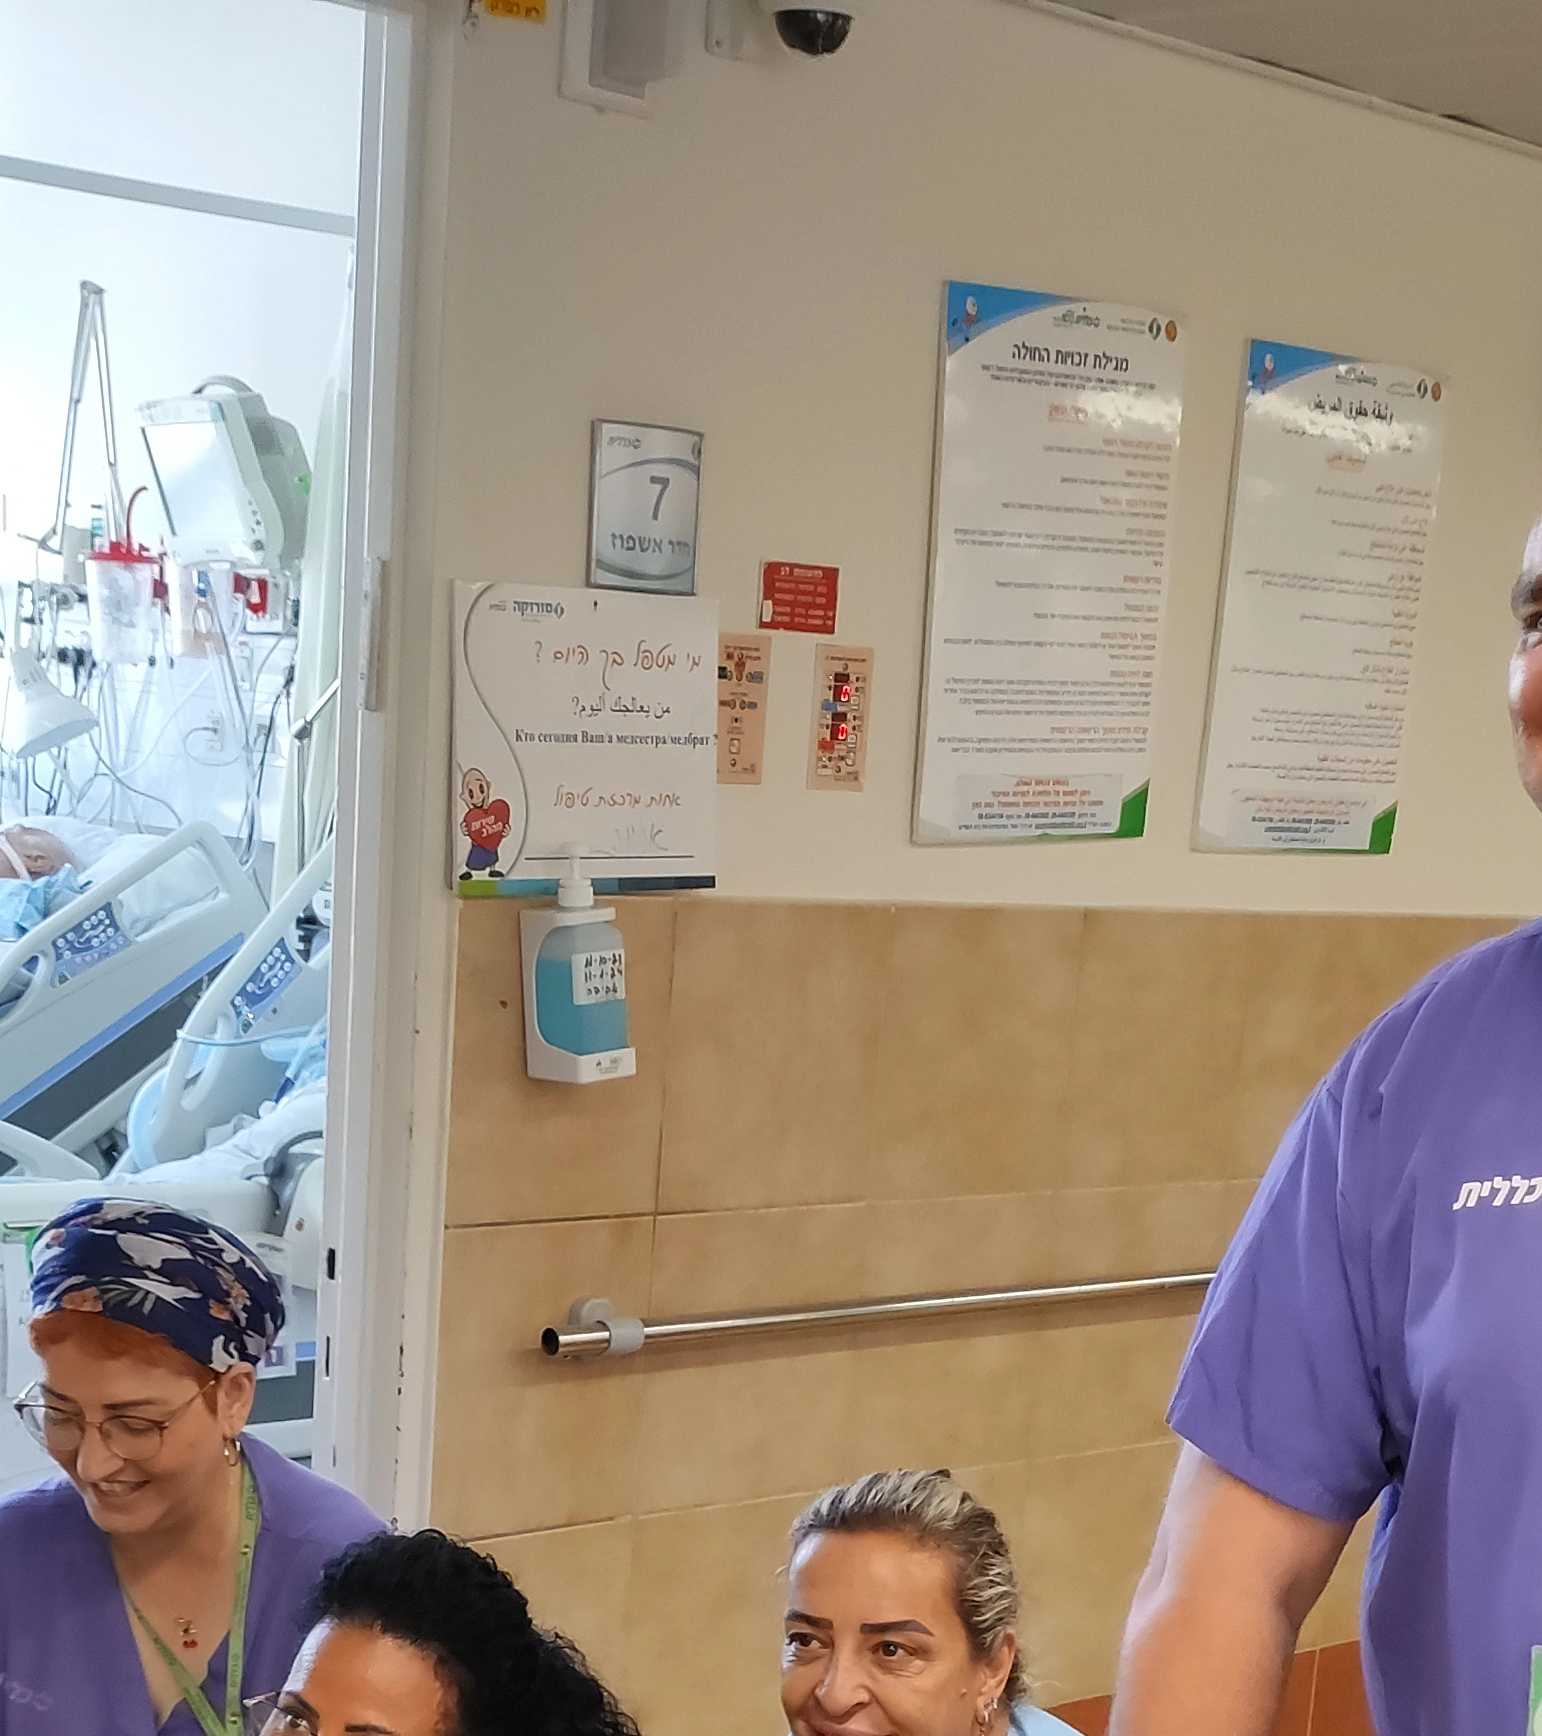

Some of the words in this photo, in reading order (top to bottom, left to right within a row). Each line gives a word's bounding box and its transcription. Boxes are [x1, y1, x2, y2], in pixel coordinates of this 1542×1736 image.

[649, 475, 670, 521] 7
[610, 531, 663, 554] אשפוז
[513, 600, 553, 617] סורוקה
